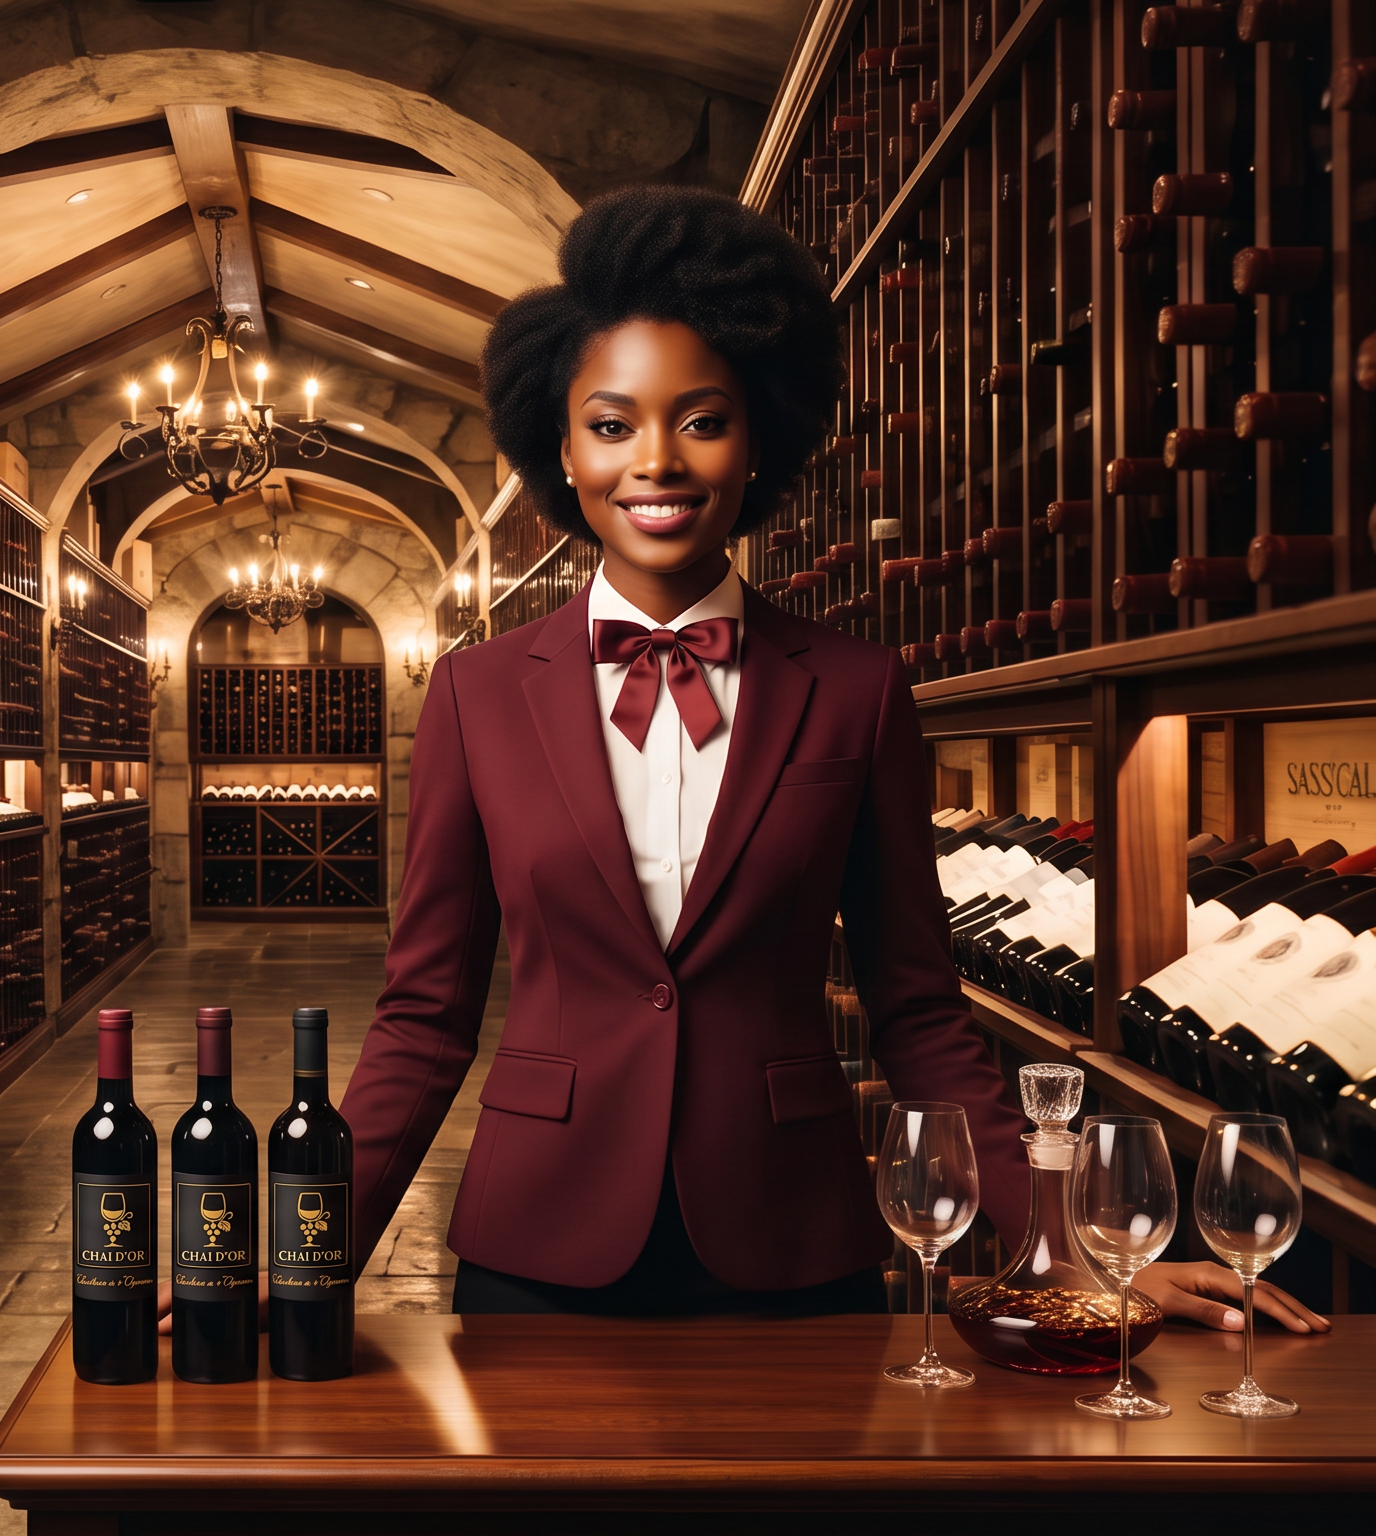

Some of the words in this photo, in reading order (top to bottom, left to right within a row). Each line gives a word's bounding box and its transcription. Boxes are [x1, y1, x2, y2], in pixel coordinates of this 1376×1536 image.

[82, 1250, 112, 1261] CHAI
[115, 1250, 145, 1261] D'OR
[181, 1250, 212, 1261] CHAI
[215, 1250, 246, 1261] D'OR
[278, 1250, 309, 1261] CHAI
[312, 1250, 342, 1261] D'OR
